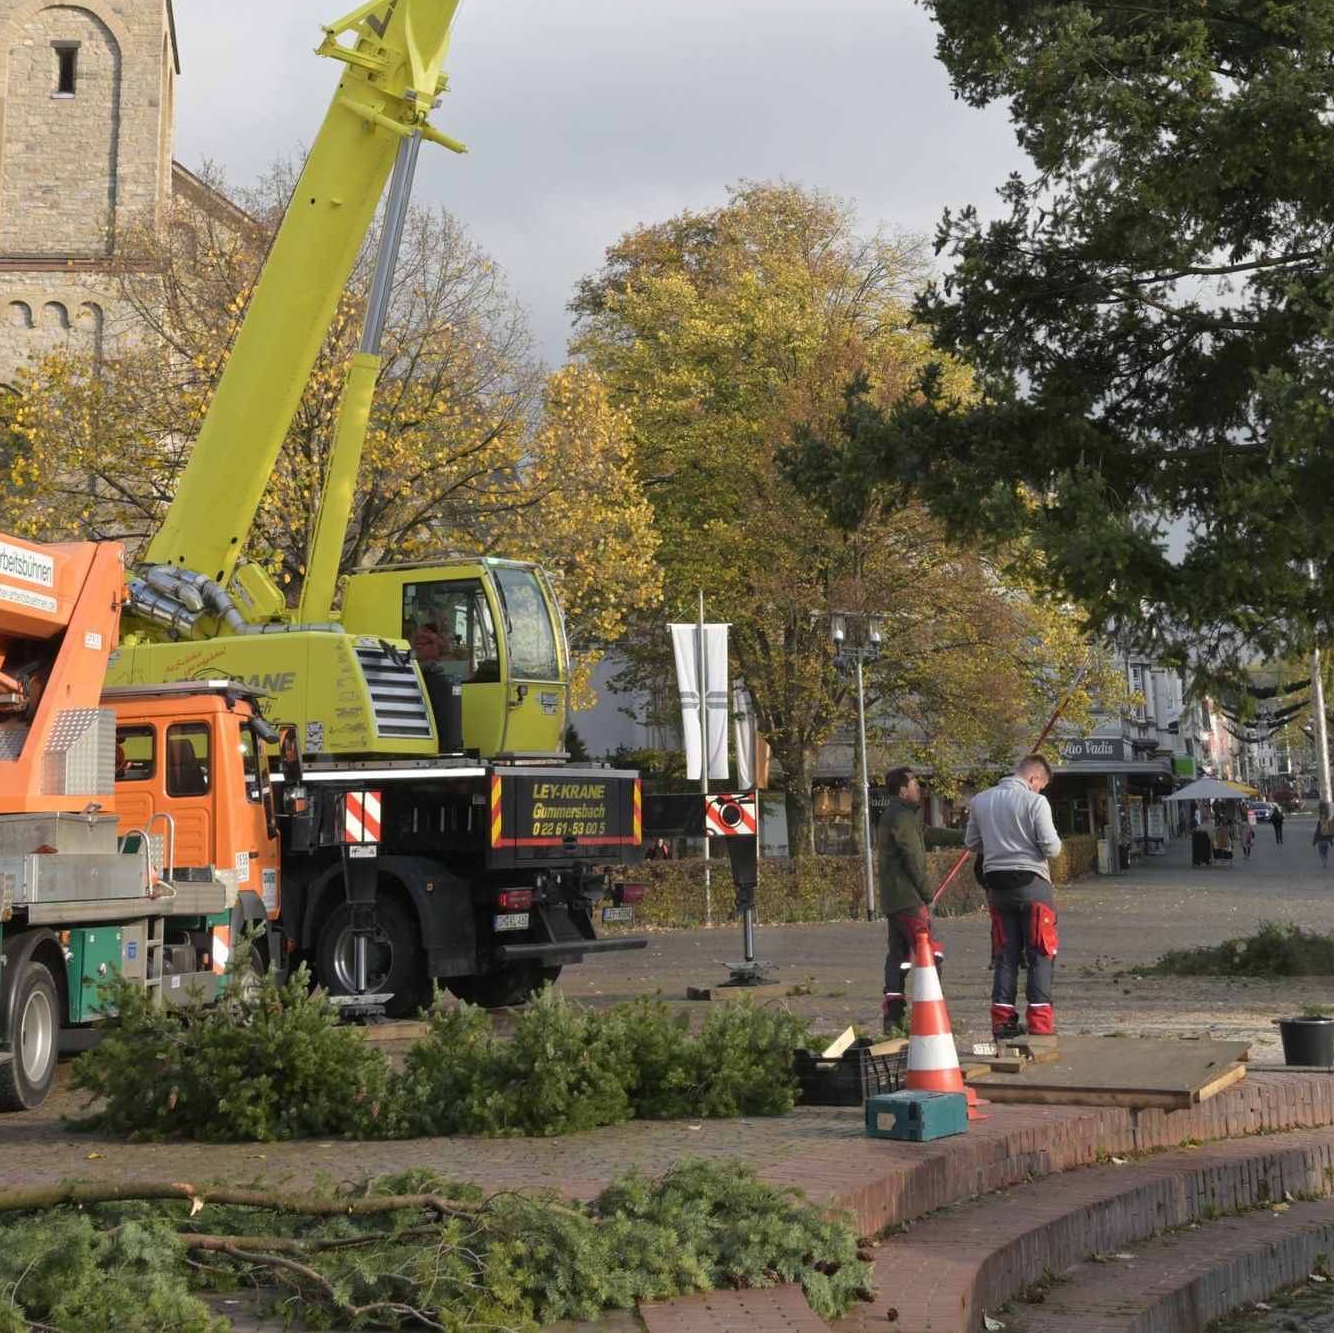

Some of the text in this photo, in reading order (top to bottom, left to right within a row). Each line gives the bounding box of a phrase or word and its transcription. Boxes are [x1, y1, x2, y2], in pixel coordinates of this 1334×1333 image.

[1084, 740, 1114, 755] Vadis
[533, 784, 606, 799] LEY-KRANE
[533, 802, 605, 819] Gummersbach
[533, 822, 606, 836] 0 22 61 53 00 5
